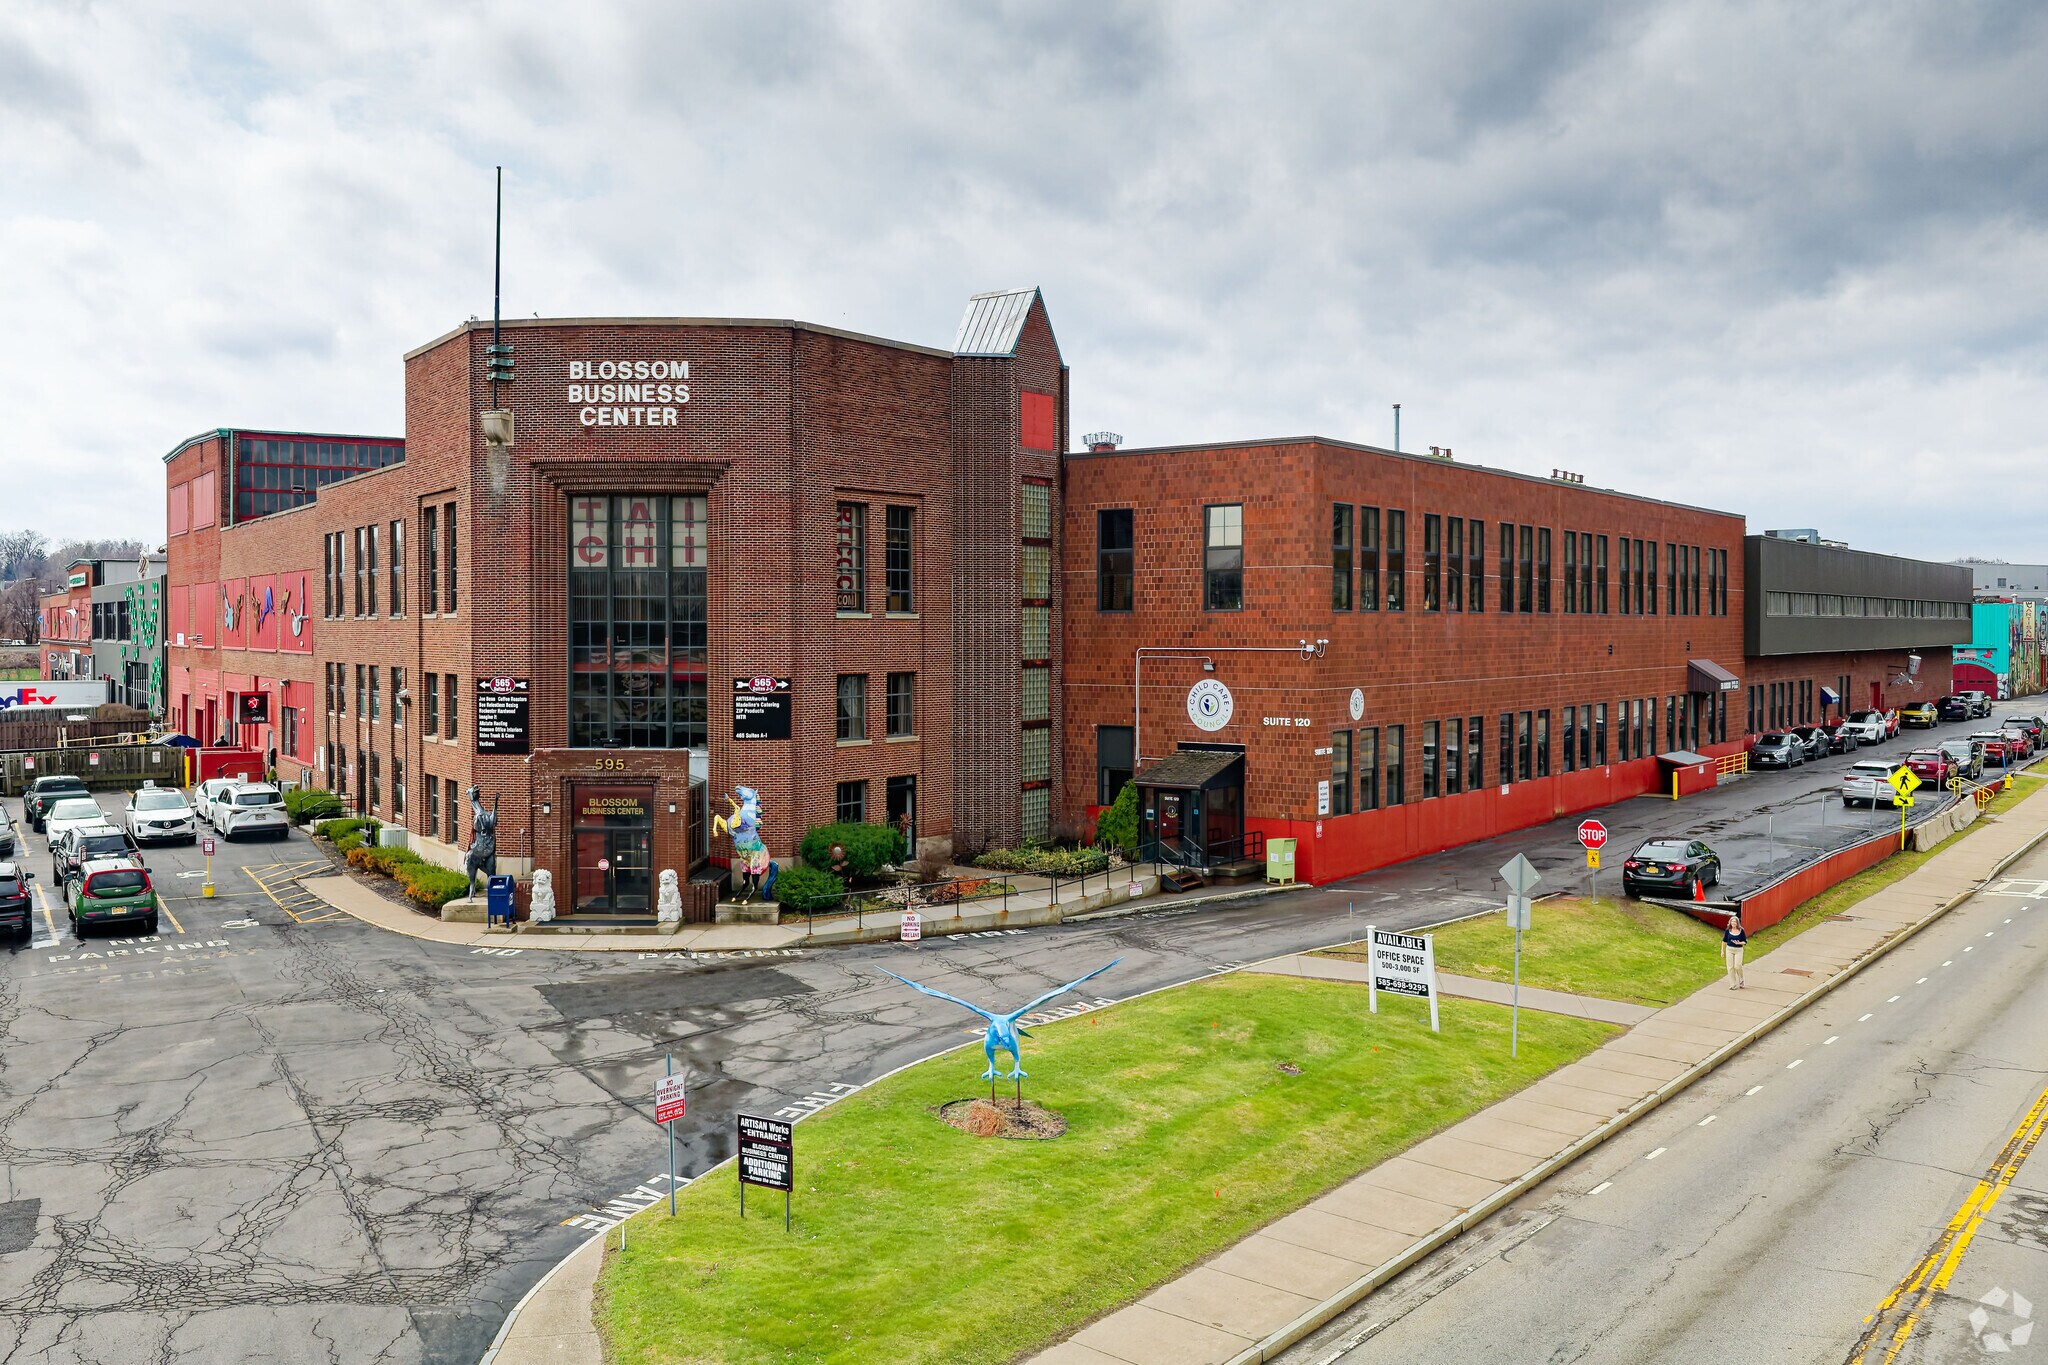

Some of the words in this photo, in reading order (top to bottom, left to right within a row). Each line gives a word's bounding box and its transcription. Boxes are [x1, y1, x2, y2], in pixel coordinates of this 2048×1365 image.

[569, 361, 689, 380] BLOSSOM
[568, 384, 690, 403] BUSINESS
[580, 406, 677, 426] CENTER
[578, 502, 695, 529] TAI
[578, 536, 695, 563] CHI
[495, 679, 511, 687] 565
[755, 679, 771, 687] 565
[1190, 682, 1208, 705] CHILD
[1213, 683, 1230, 706] CARE
[1192, 713, 1228, 728] COUNCIL
[1263, 717, 1291, 726] SUITE
[1294, 718, 1311, 727] 120
[595, 758, 625, 771] 595
[589, 798, 638, 807] BLOSSOM
[582, 807, 616, 815] BUSINESS
[617, 807, 644, 815] CENTER
[1580, 828, 1606, 841] STOP
[109, 935, 162, 947] NO
[946, 929, 1029, 941] FIRE
[1377, 933, 1423, 950] AVAILABLE
[48, 939, 230, 963] PARKING
[470, 948, 524, 956] NO
[638, 949, 804, 960] PARKING
[1377, 950, 1401, 962] OFFICE
[1402, 954, 1425, 966] SPACE
[1382, 962, 1412, 973] 500-3,000
[1413, 966, 1420, 974] SF
[1377, 977, 1427, 992] 585-698-9295
[657, 1083, 683, 1096] OVERNIGHT
[667, 1079, 674, 1087] NO
[660, 1091, 680, 1102] PARKING
[740, 1117, 768, 1131] ARTISAN
[768, 1122, 790, 1135] Works
[742, 1147, 767, 1157] BUSINESS
[768, 1152, 788, 1161] CENTER
[752, 1143, 777, 1153] BLOSSOM
[743, 1157, 787, 1173] ADDITIONAL
[748, 1166, 782, 1180] PARKING
